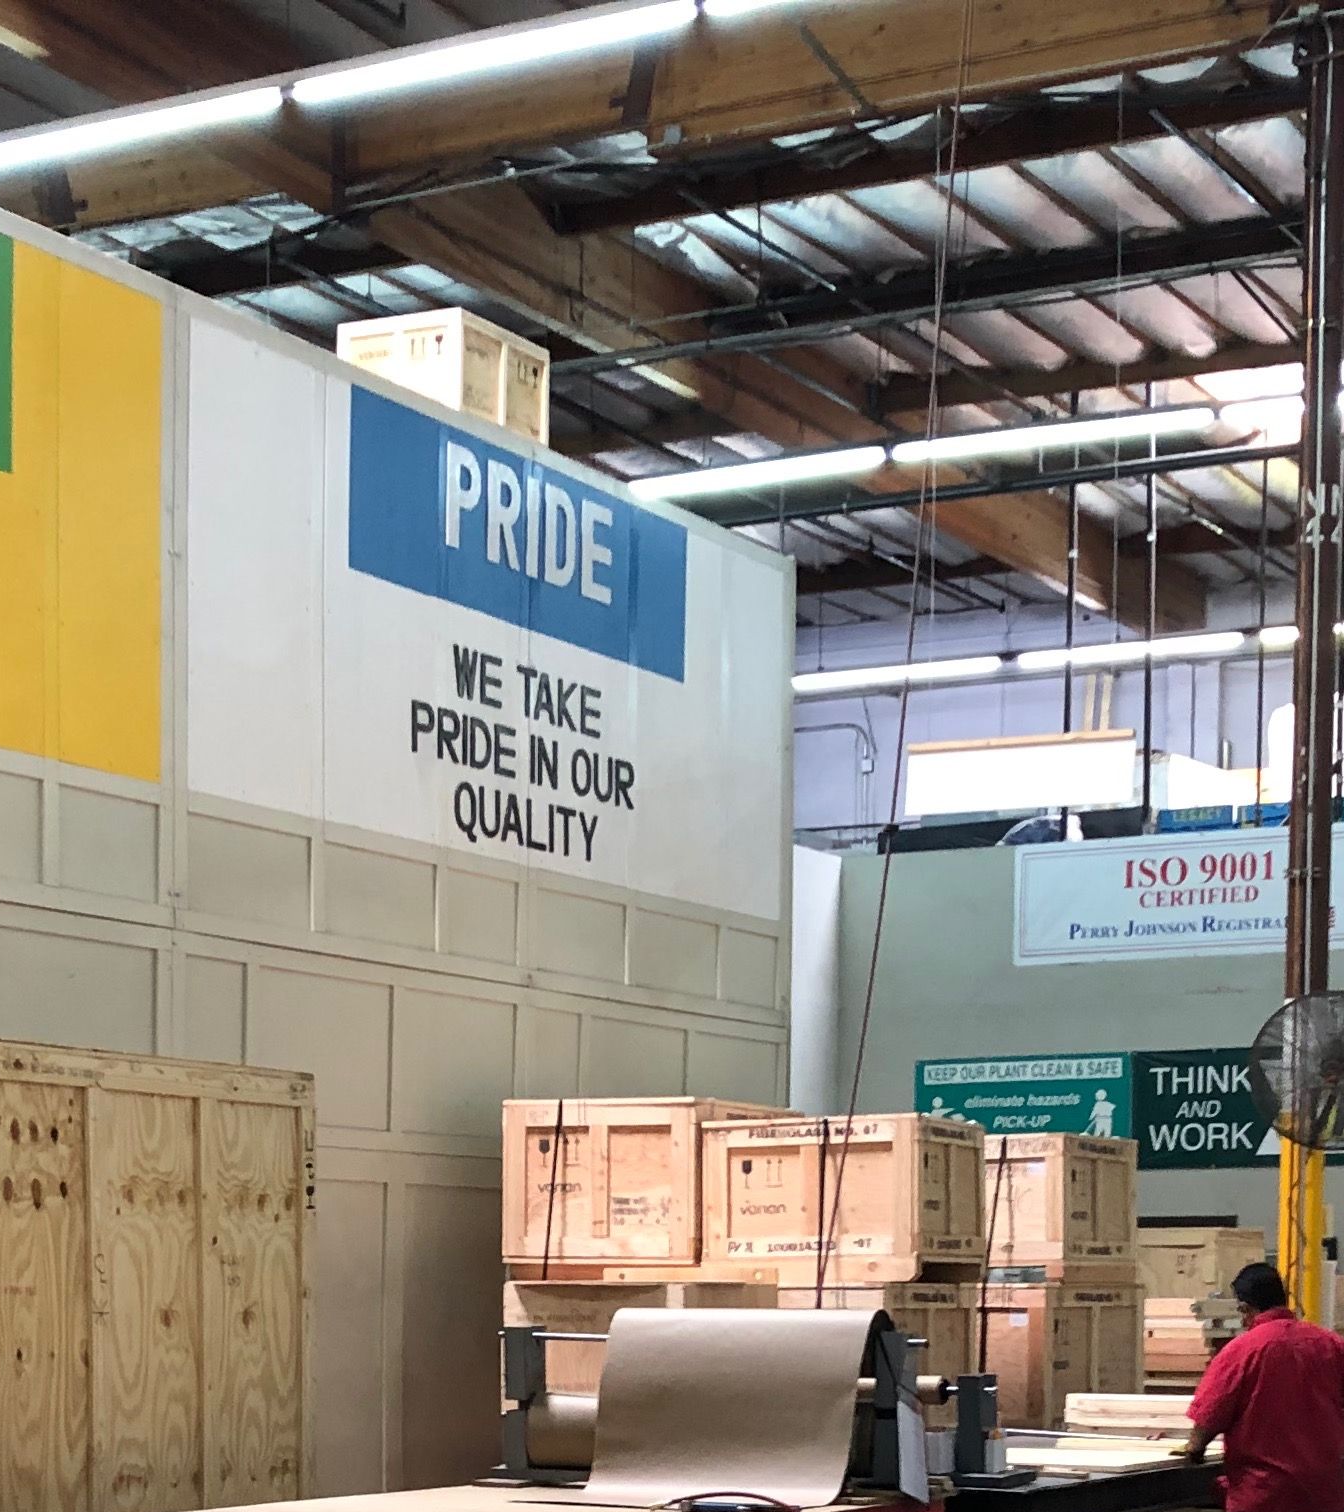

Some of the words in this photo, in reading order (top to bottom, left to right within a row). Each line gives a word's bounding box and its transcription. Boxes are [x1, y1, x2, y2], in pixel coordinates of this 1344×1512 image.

[445, 440, 613, 605] PRIDE
[453, 644, 503, 709] WE
[517, 665, 601, 739] TAKE
[411, 700, 516, 779] PRIDE
[530, 734, 558, 790] IN
[571, 748, 635, 809] OUR
[454, 782, 598, 861] QUALITY
[1124, 856, 1187, 889] ISO
[1199, 850, 1274, 884] 9001
[1138, 885, 1260, 909] CERTIFIED
[1069, 922, 1119, 939] PERRY
[1123, 918, 1197, 938] JOHNSON
[926, 1067, 957, 1082] KEEP
[960, 1066, 987, 1080] OUR
[989, 1064, 1028, 1079] PLANT
[1030, 1062, 1073, 1078] CLEAN
[1076, 1061, 1084, 1077] &
[1086, 1059, 1120, 1076] SAFE
[1149, 1065, 1253, 1096] THINK
[964, 1094, 1026, 1109] eliminate
[1027, 1092, 1081, 1107] hazards
[1175, 1100, 1222, 1119] AND
[993, 1115, 1052, 1129] PICK-UP
[1149, 1121, 1254, 1152] WORK
